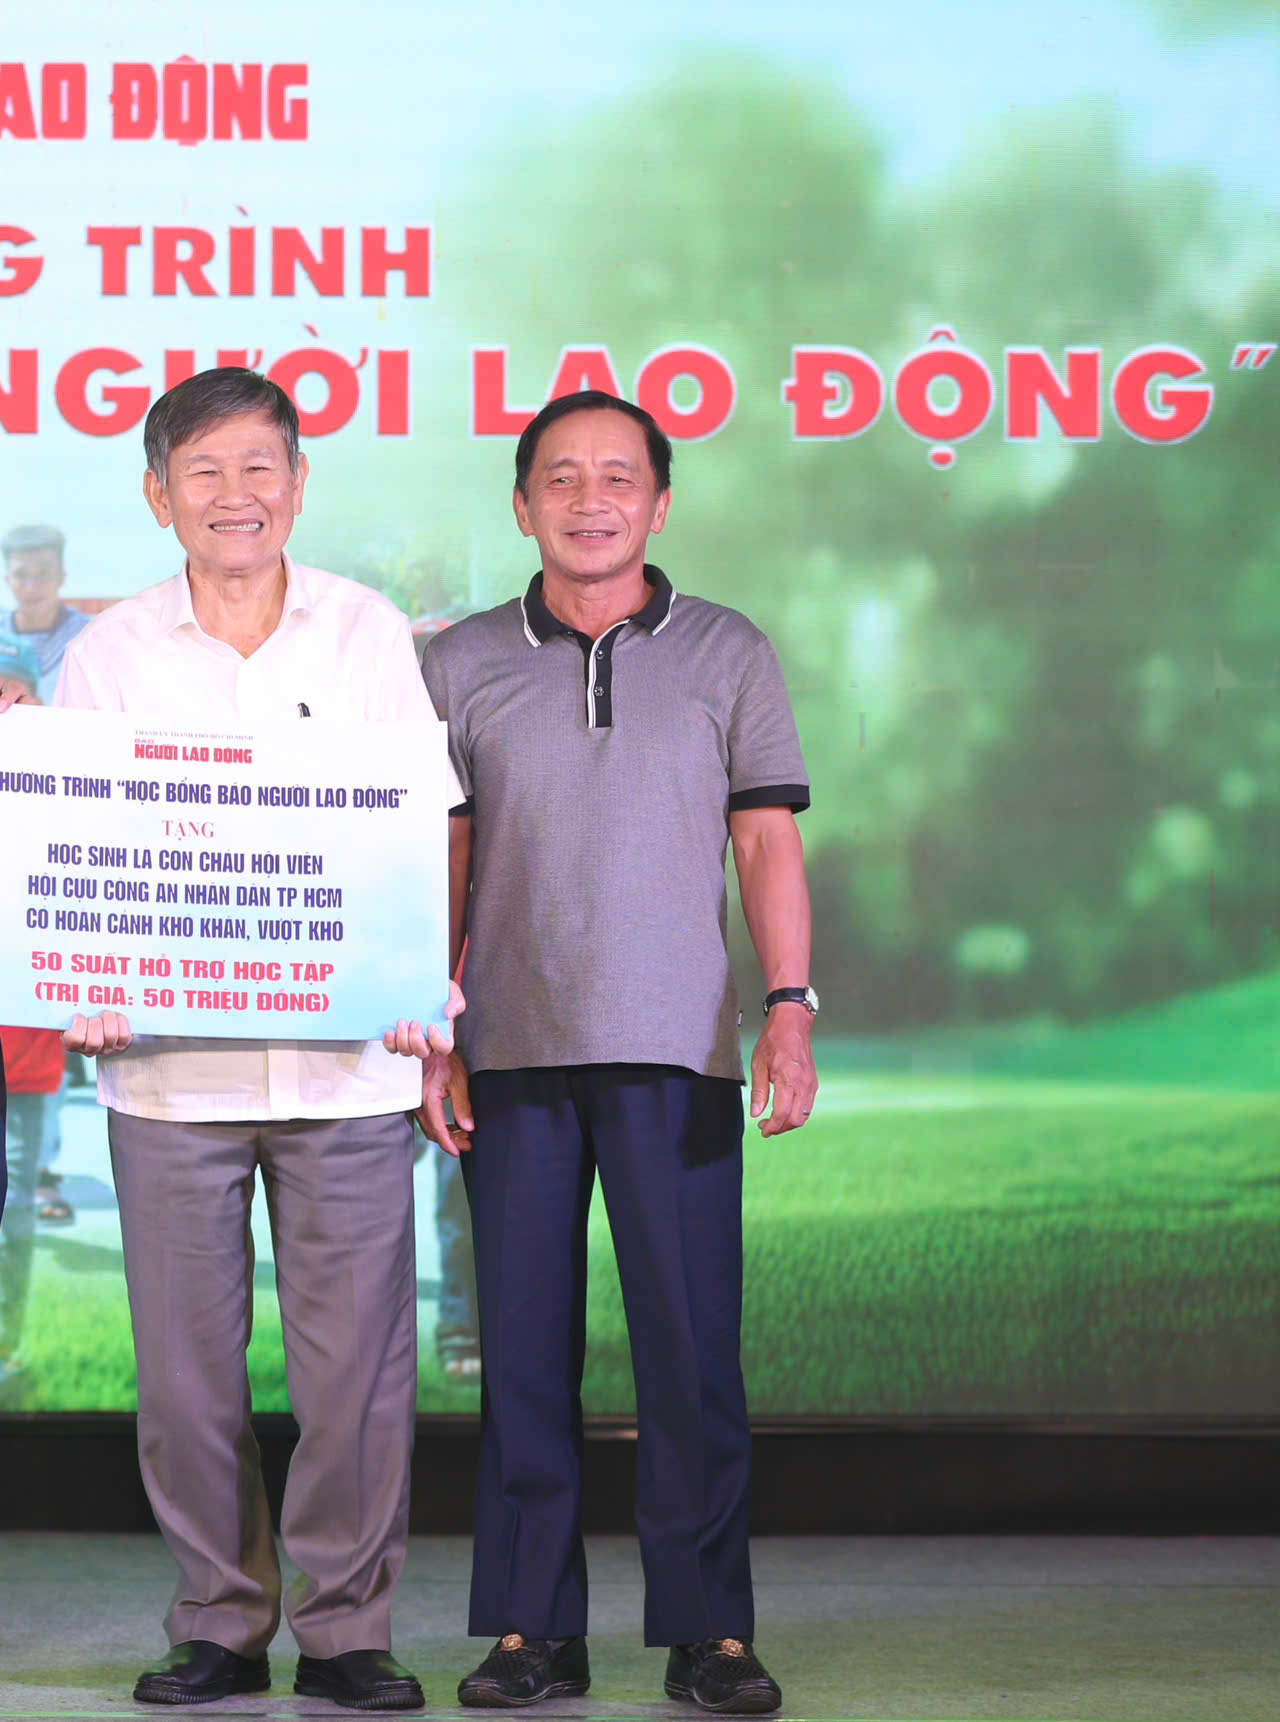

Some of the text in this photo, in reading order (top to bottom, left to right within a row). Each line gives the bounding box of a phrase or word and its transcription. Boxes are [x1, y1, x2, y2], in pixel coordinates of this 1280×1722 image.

[109, 54, 309, 146] ĐỘNG
[87, 205, 431, 298] TRÌNH
[182, 746, 209, 762] LAO
[62, 774, 111, 799] TRÌNH
[166, 776, 211, 804] BỔNG
[218, 782, 251, 806] BÁO
[258, 784, 310, 807] NGƯỜI
[316, 788, 346, 808] LAO
[48, 843, 82, 869] HỌC
[88, 846, 127, 868] SINH
[159, 850, 193, 871] CON
[251, 850, 280, 878] HỘI
[286, 851, 323, 875] VIÊN
[28, 872, 343, 908] HỘI CỰU CÔNG AN NHÂN DÂN TP HCM
[258, 918, 302, 945] VƯỢT
[32, 951, 62, 971] 50
[71, 952, 131, 975] SUẤT
[179, 959, 226, 983] TRỢ
[233, 961, 282, 984] HỌC
[289, 960, 334, 985] TẬP
[35, 982, 79, 1006] (TRỊ
[144, 988, 174, 1008] 50
[183, 988, 249, 1014] TRIỆU
